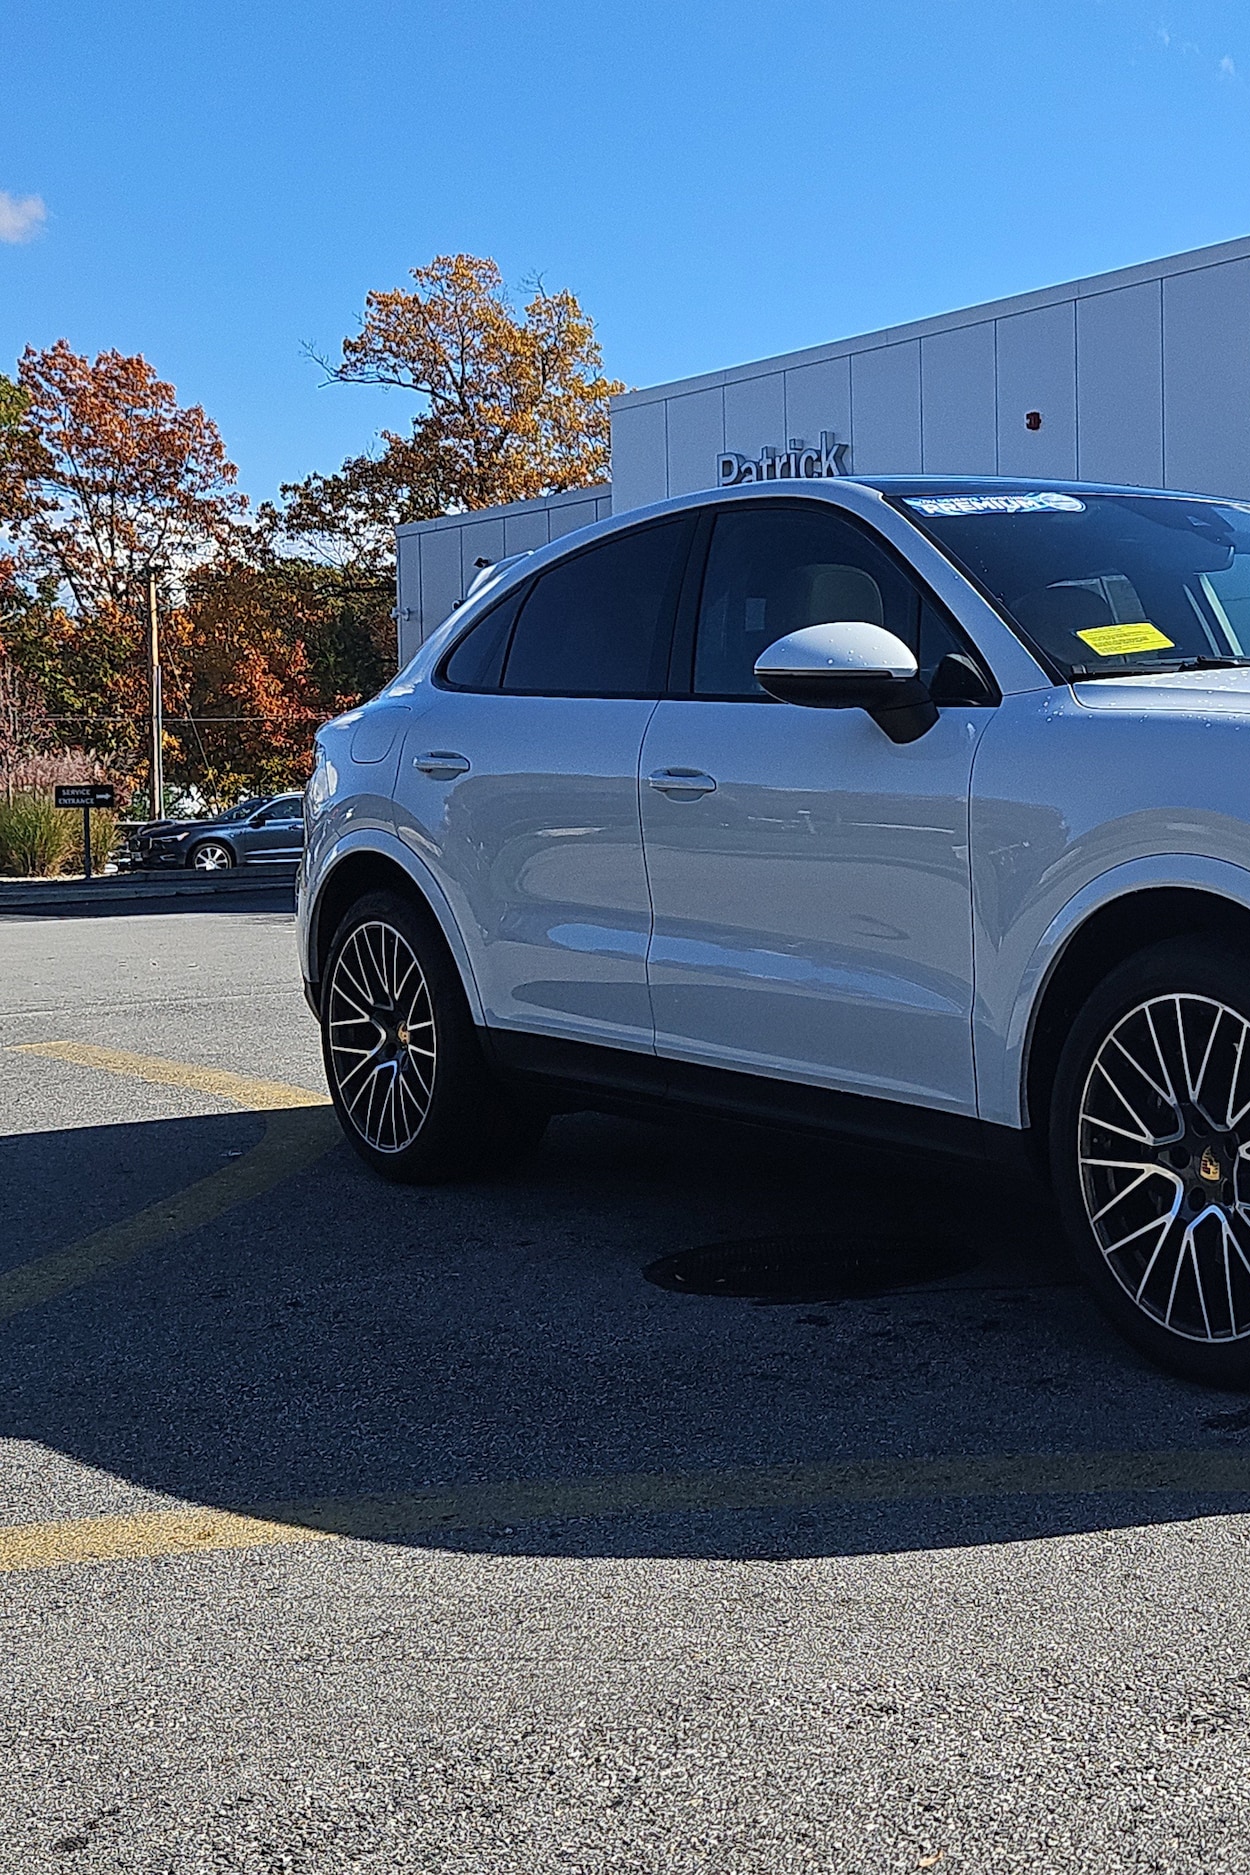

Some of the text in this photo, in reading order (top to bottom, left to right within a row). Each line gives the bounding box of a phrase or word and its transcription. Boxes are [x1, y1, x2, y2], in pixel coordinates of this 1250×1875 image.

[717, 430, 849, 487] Patrick
[61, 788, 91, 796] SERVICE
[58, 797, 95, 805] ENTRANCE
